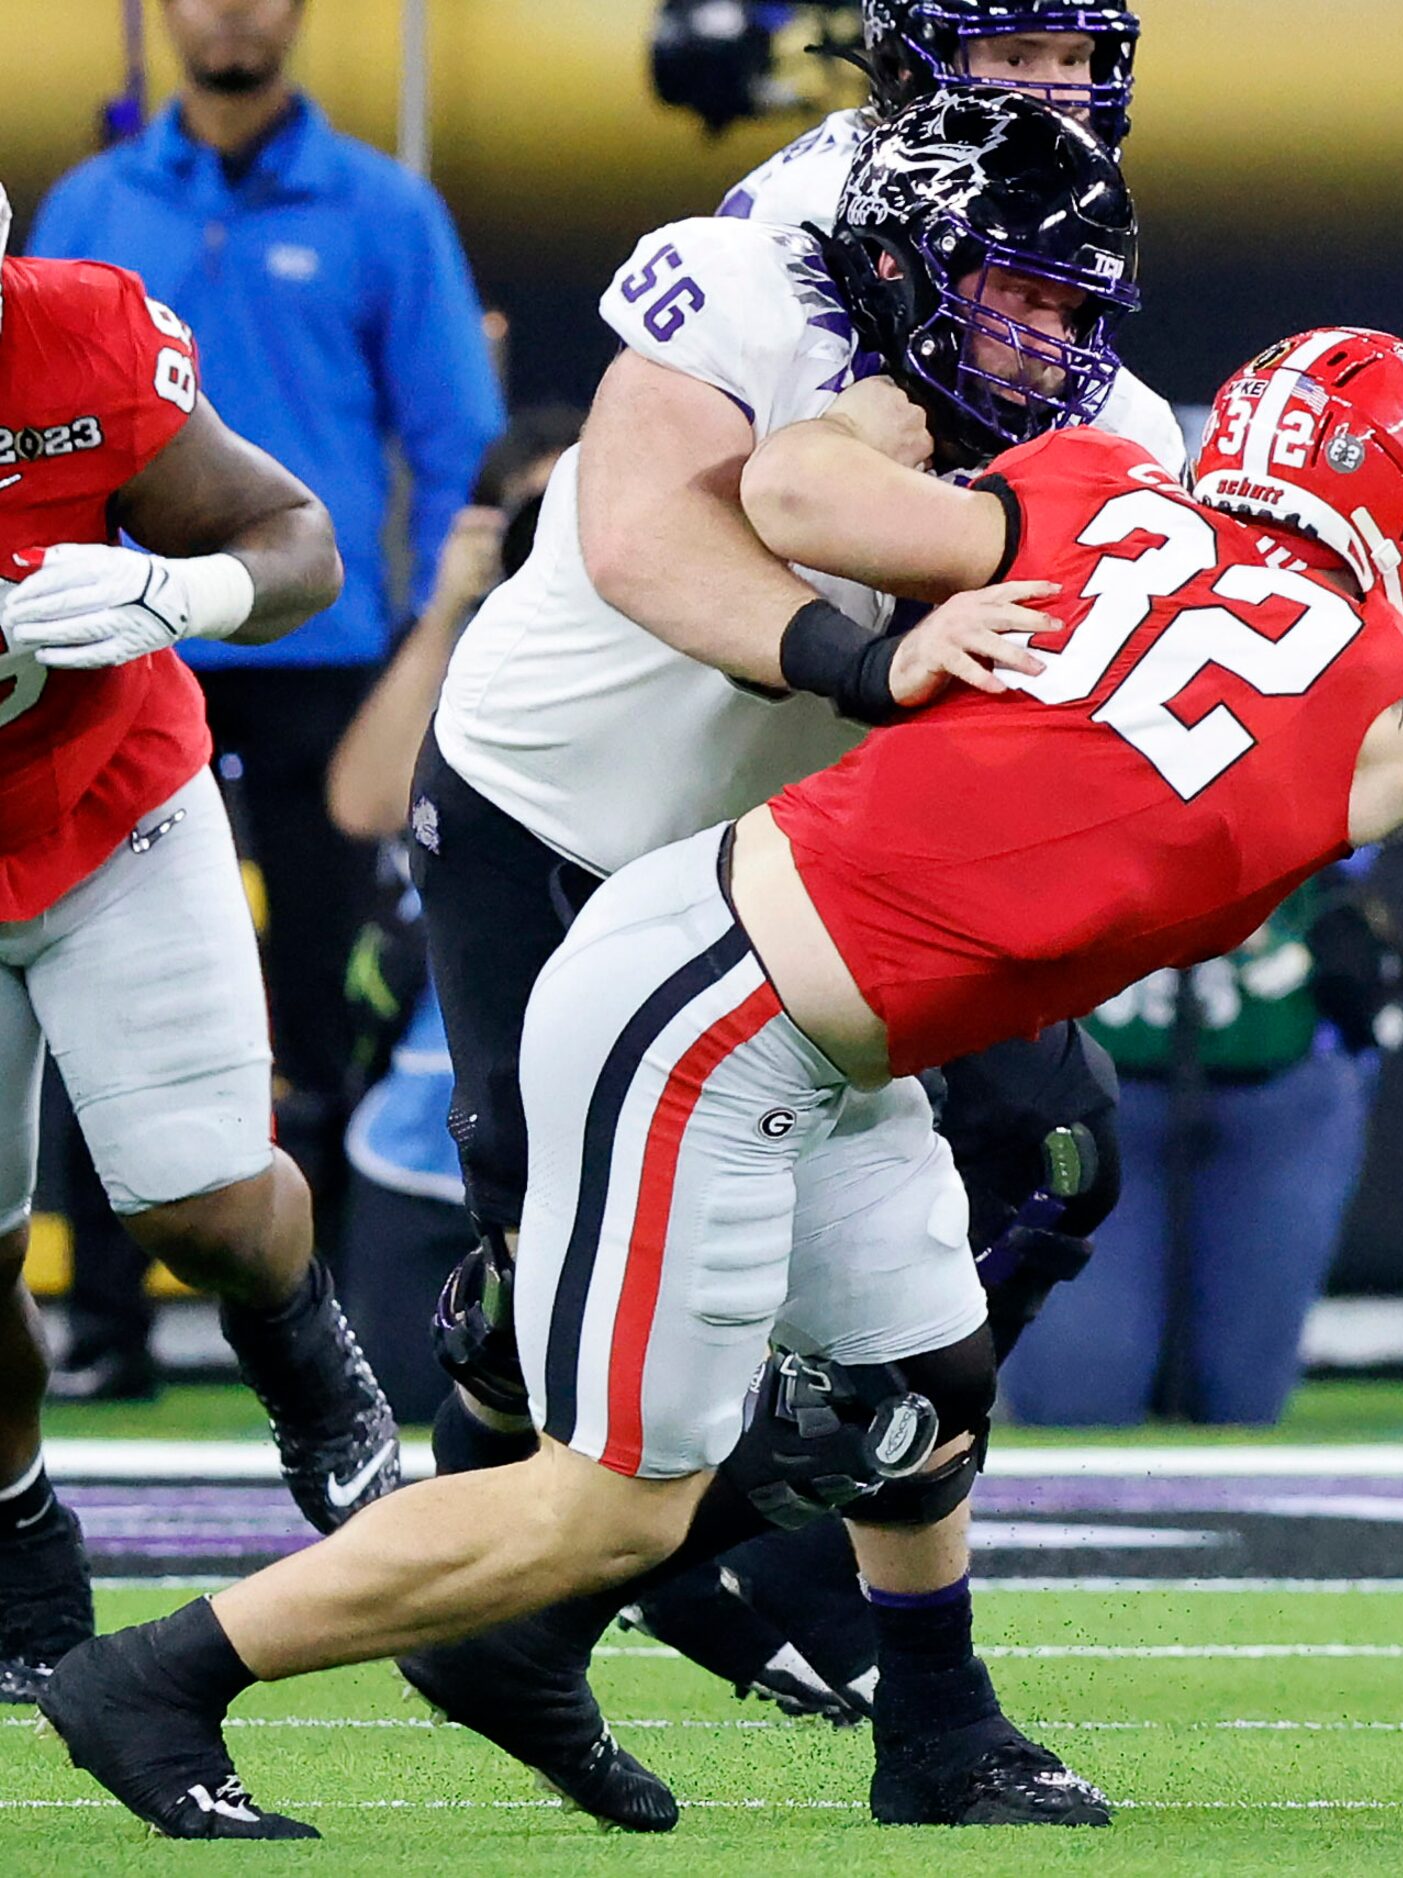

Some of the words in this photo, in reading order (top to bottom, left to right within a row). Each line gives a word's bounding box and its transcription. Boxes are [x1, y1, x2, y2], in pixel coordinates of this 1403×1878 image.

[1094, 252, 1125, 279] TCU
[621, 242, 705, 342] 56
[1216, 477, 1284, 505] schutt
[994, 488, 1364, 805] 32
[759, 1109, 796, 1140] G
